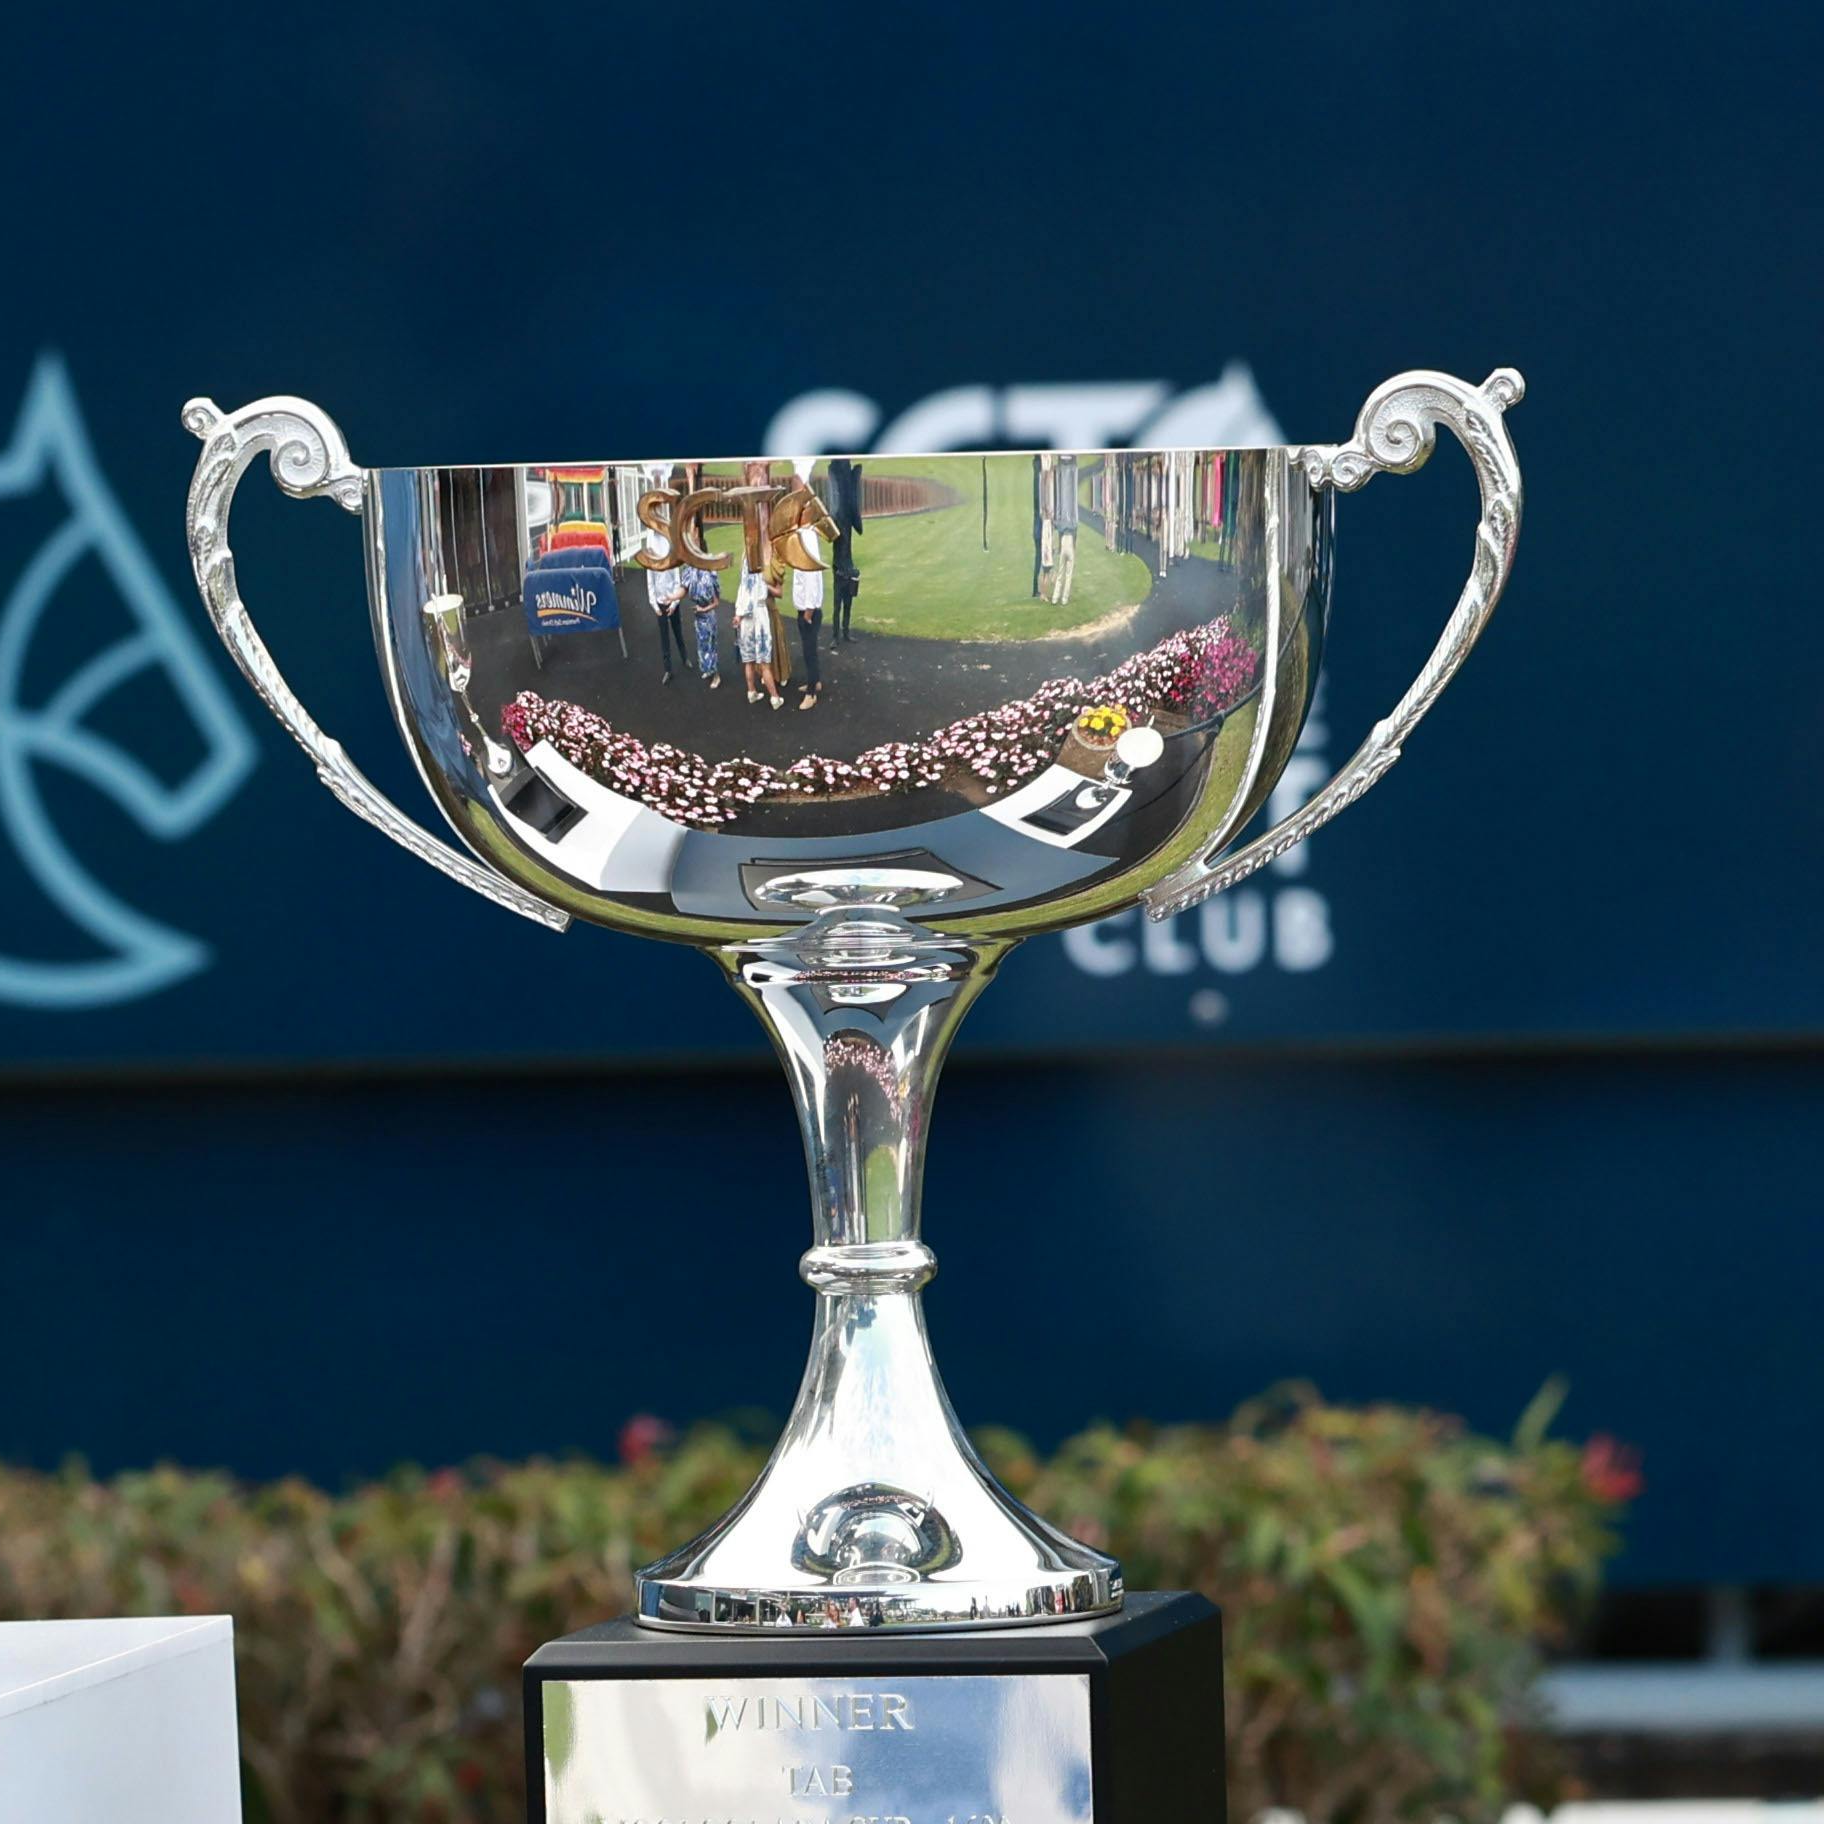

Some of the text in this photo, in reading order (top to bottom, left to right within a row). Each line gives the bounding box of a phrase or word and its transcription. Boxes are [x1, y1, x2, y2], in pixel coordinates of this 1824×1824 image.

[1063, 888, 1333, 978] CLUB
[704, 1693, 915, 1732] WINNER
[783, 1763, 854, 1797] TAB
